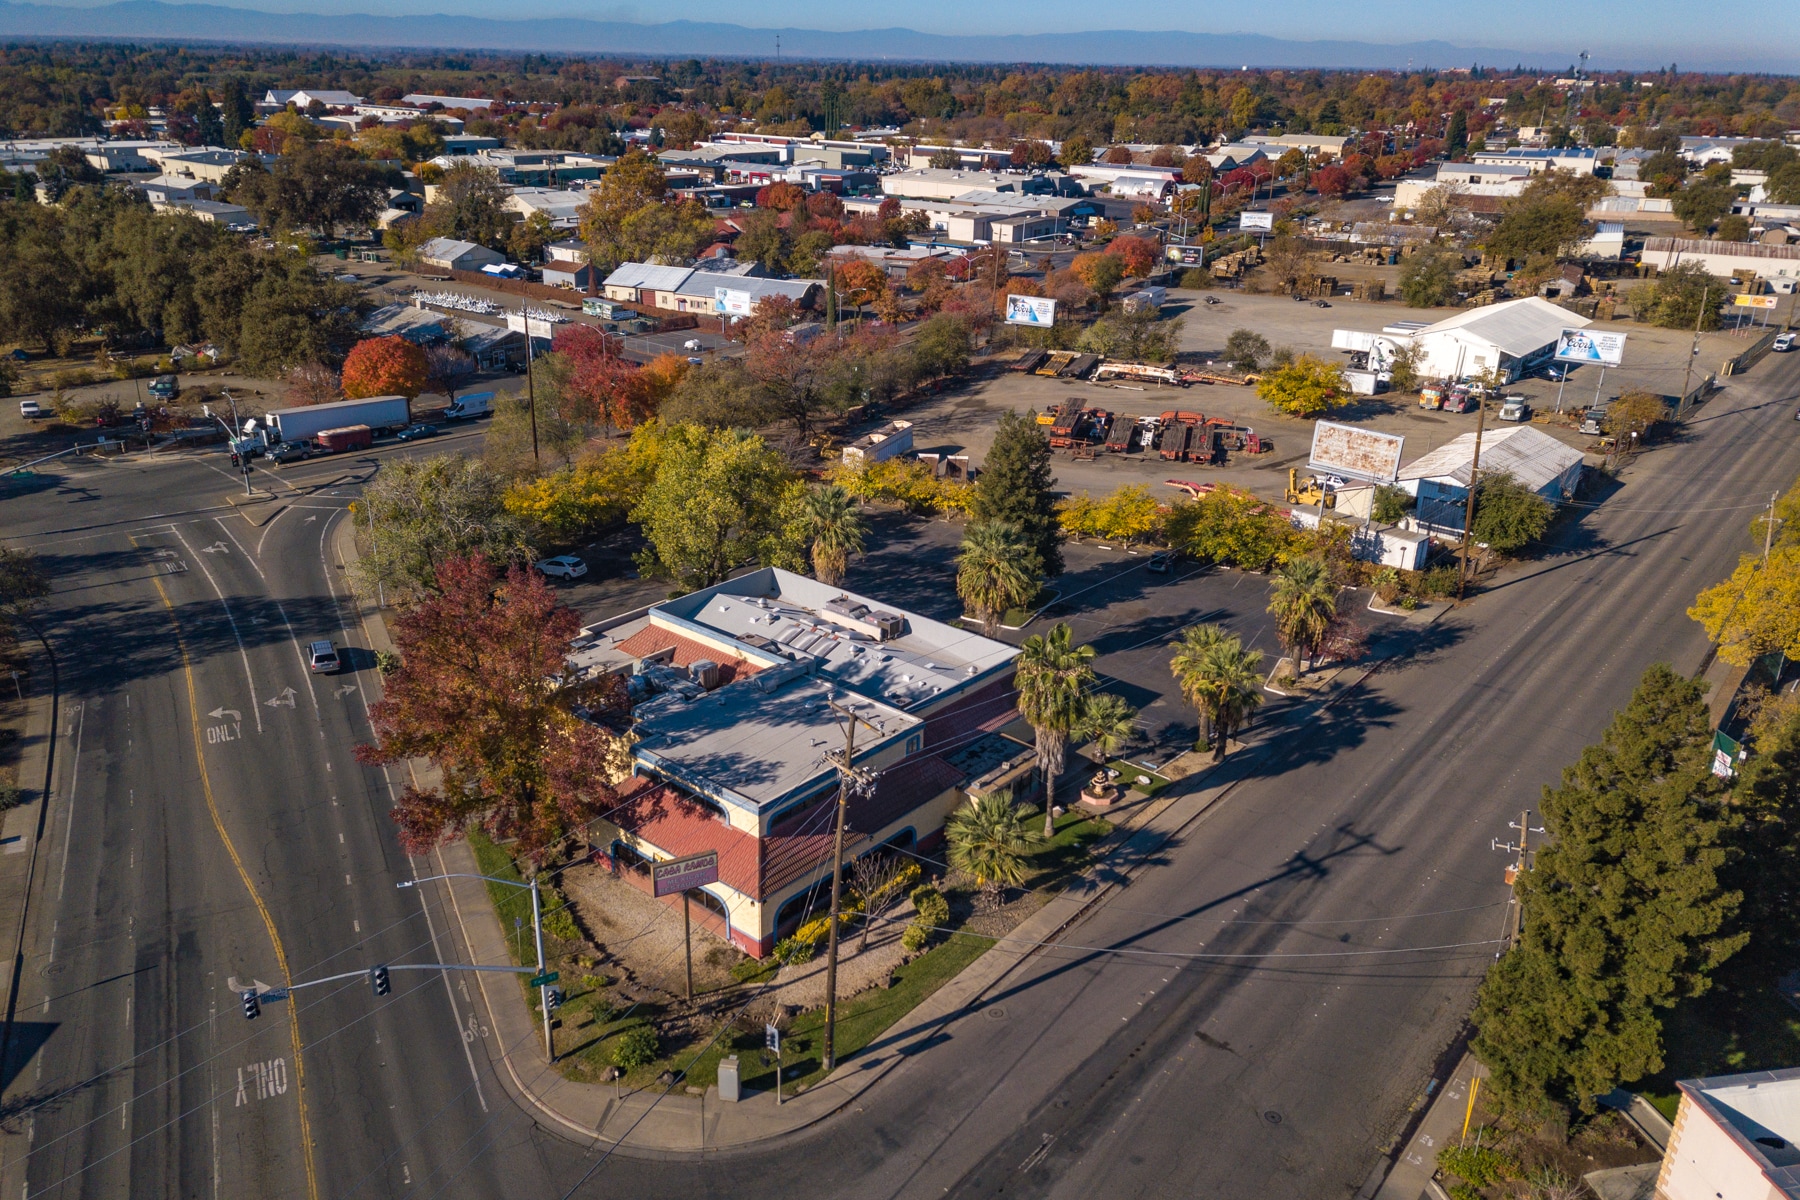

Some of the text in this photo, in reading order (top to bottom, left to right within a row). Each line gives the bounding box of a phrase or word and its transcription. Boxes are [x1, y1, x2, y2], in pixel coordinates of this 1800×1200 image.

[1013, 304, 1032, 313] Coors
[1567, 338, 1593, 349] Coors
[206, 721, 241, 744] ONLY
[657, 857, 714, 878] CASA RAMOS
[235, 1057, 287, 1107] ONLY
